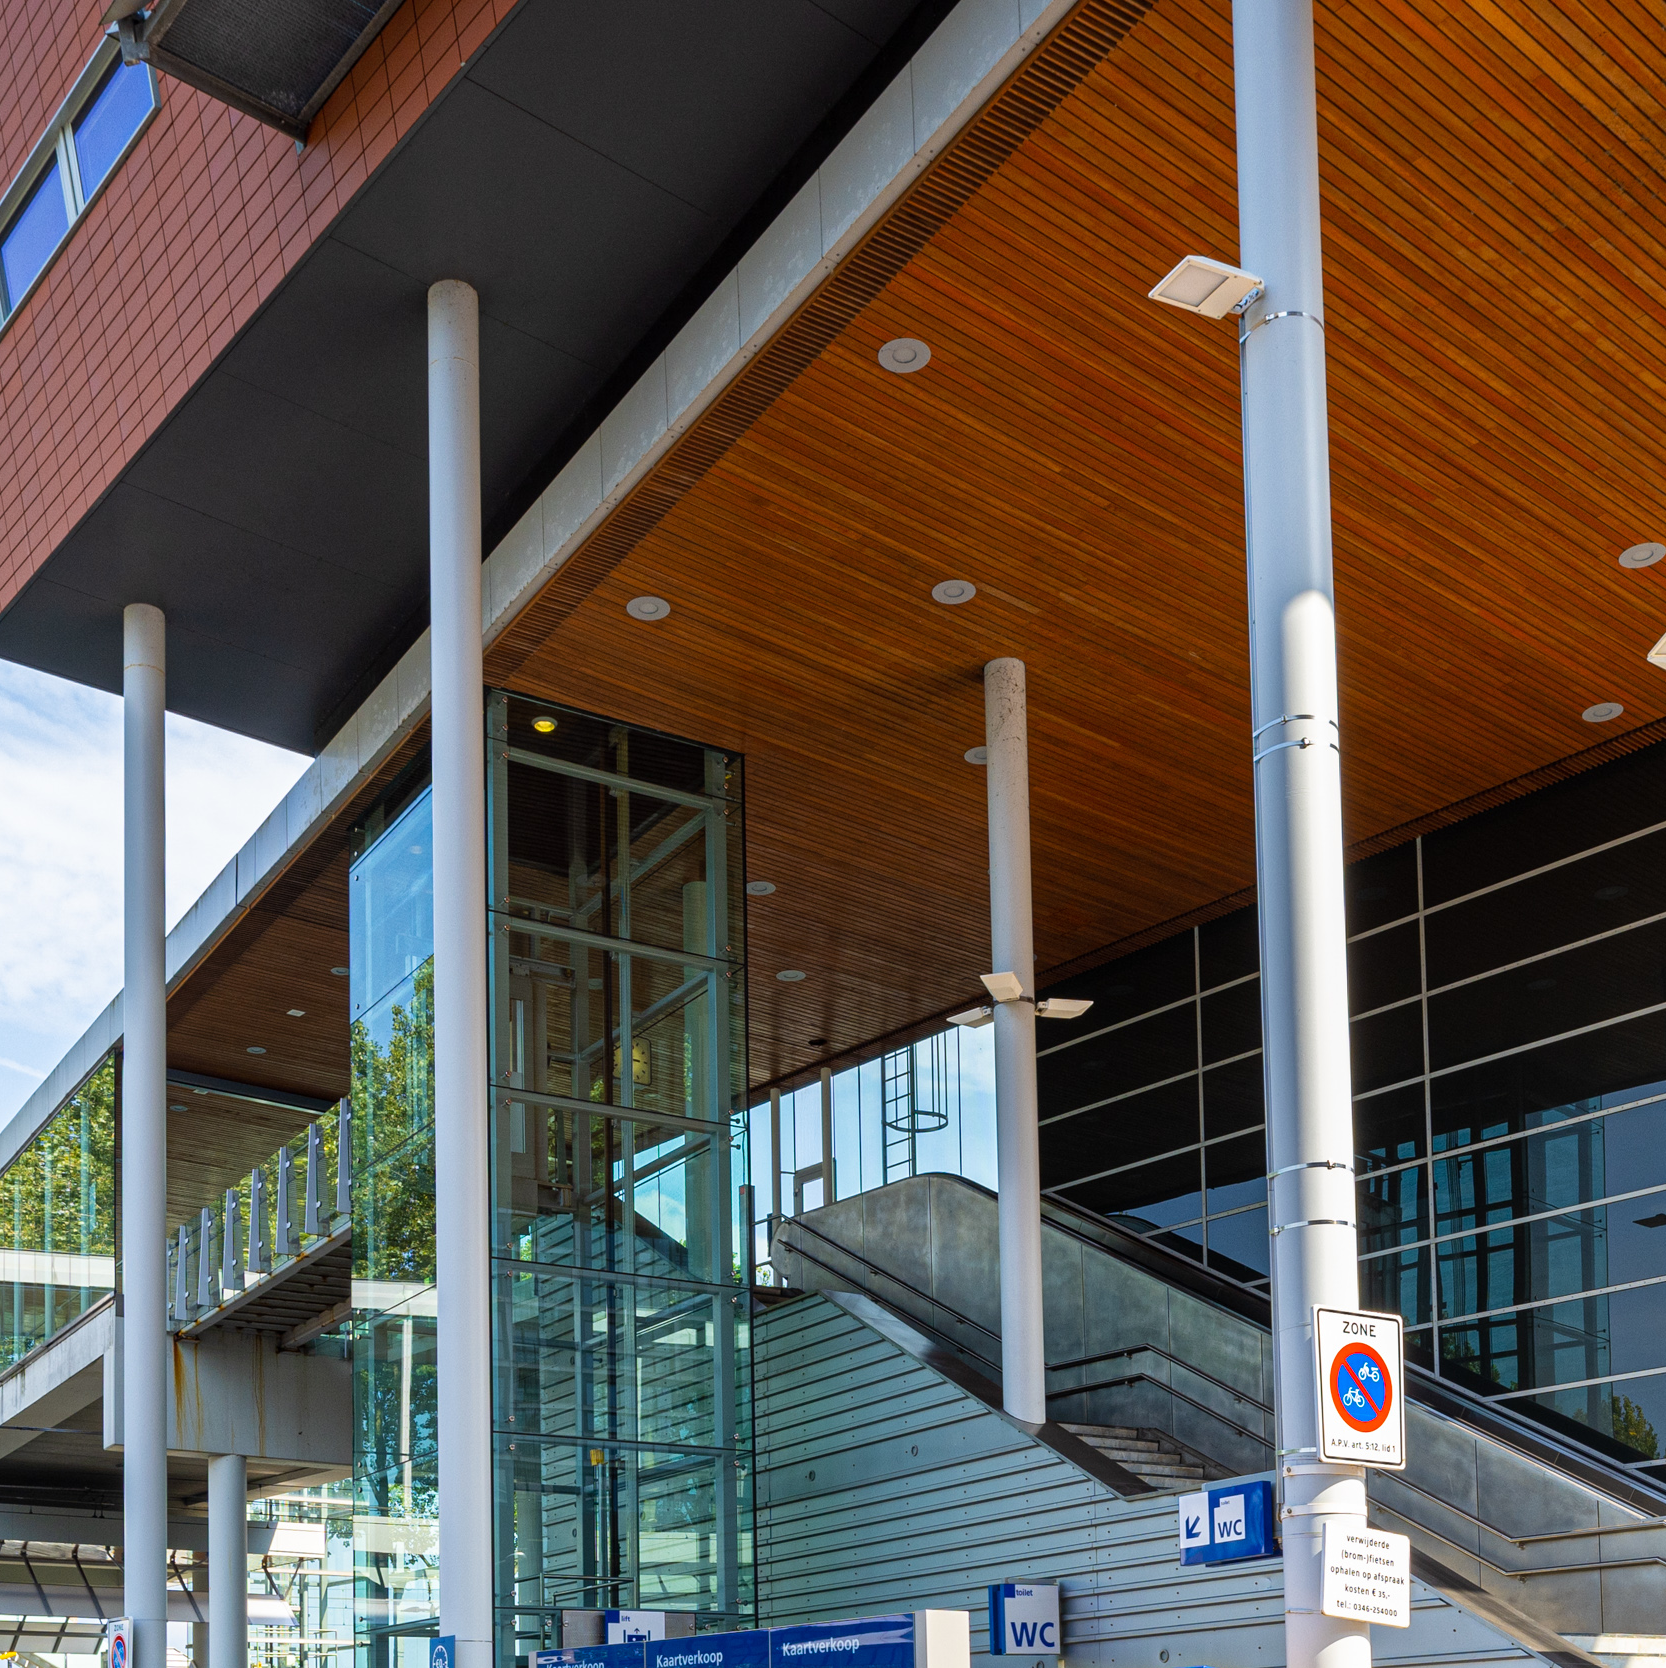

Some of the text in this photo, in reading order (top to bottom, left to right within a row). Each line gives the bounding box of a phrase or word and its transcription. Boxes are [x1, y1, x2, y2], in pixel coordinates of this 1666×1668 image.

[1342, 1320, 1376, 1338] ZONE
[1351, 1441, 1364, 1450] art.
[1381, 1443, 1391, 1453] lid
[1217, 1519, 1242, 1538] WC
[1346, 1535, 1390, 1550] verwijderde
[1341, 1549, 1395, 1567] (brom-)fietsen
[1330, 1565, 1405, 1585] ophalen op afspraak
[1016, 1588, 1033, 1597] toilet
[1344, 1583, 1391, 1599] kosten € 35,-
[1353, 1603, 1398, 1617] 0346-254000
[1010, 1622, 1055, 1648] WC
[782, 1637, 860, 1656] Kaartverkoop
[656, 1650, 723, 1668] Kaartverkoop
